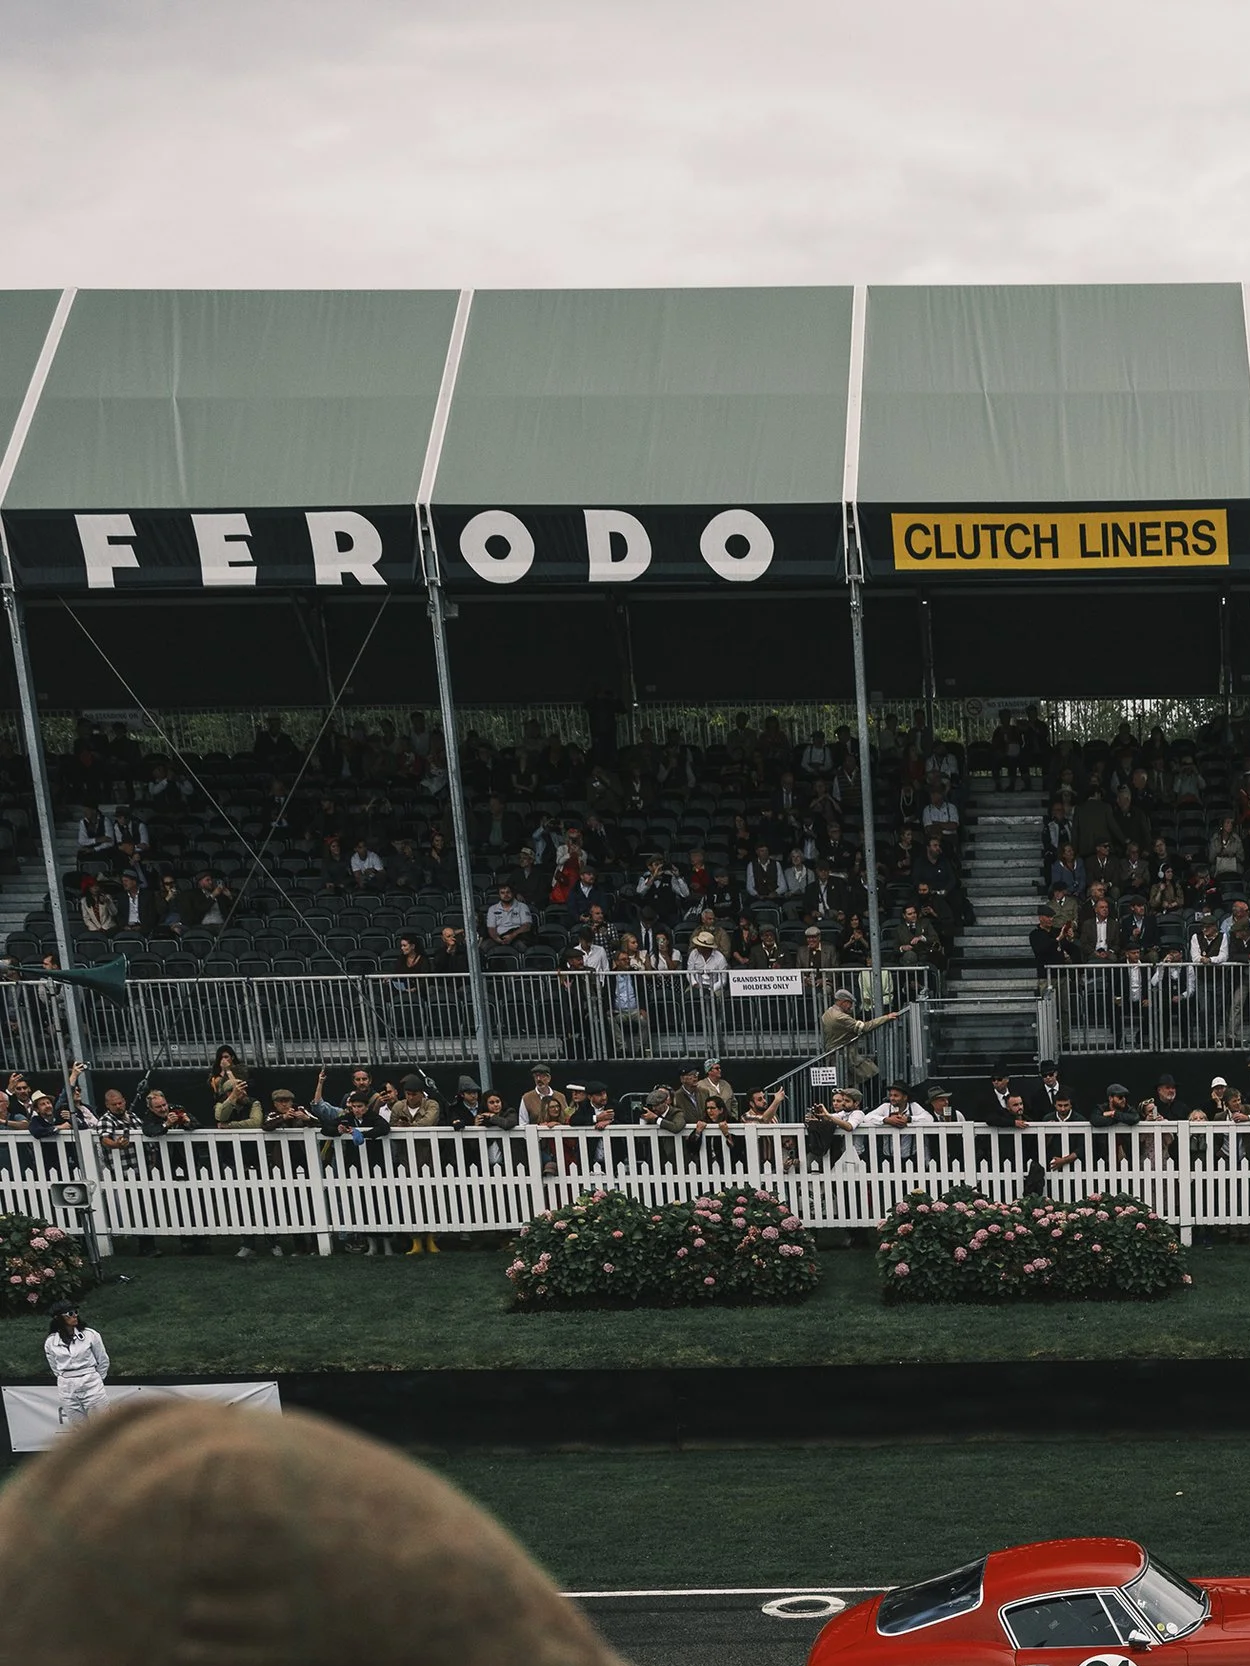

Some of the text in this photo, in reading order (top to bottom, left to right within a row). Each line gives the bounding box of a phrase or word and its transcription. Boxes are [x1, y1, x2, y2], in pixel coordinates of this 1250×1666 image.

[74, 508, 775, 589] FERODO
[904, 519, 1218, 561] CLUTCH LINERS
